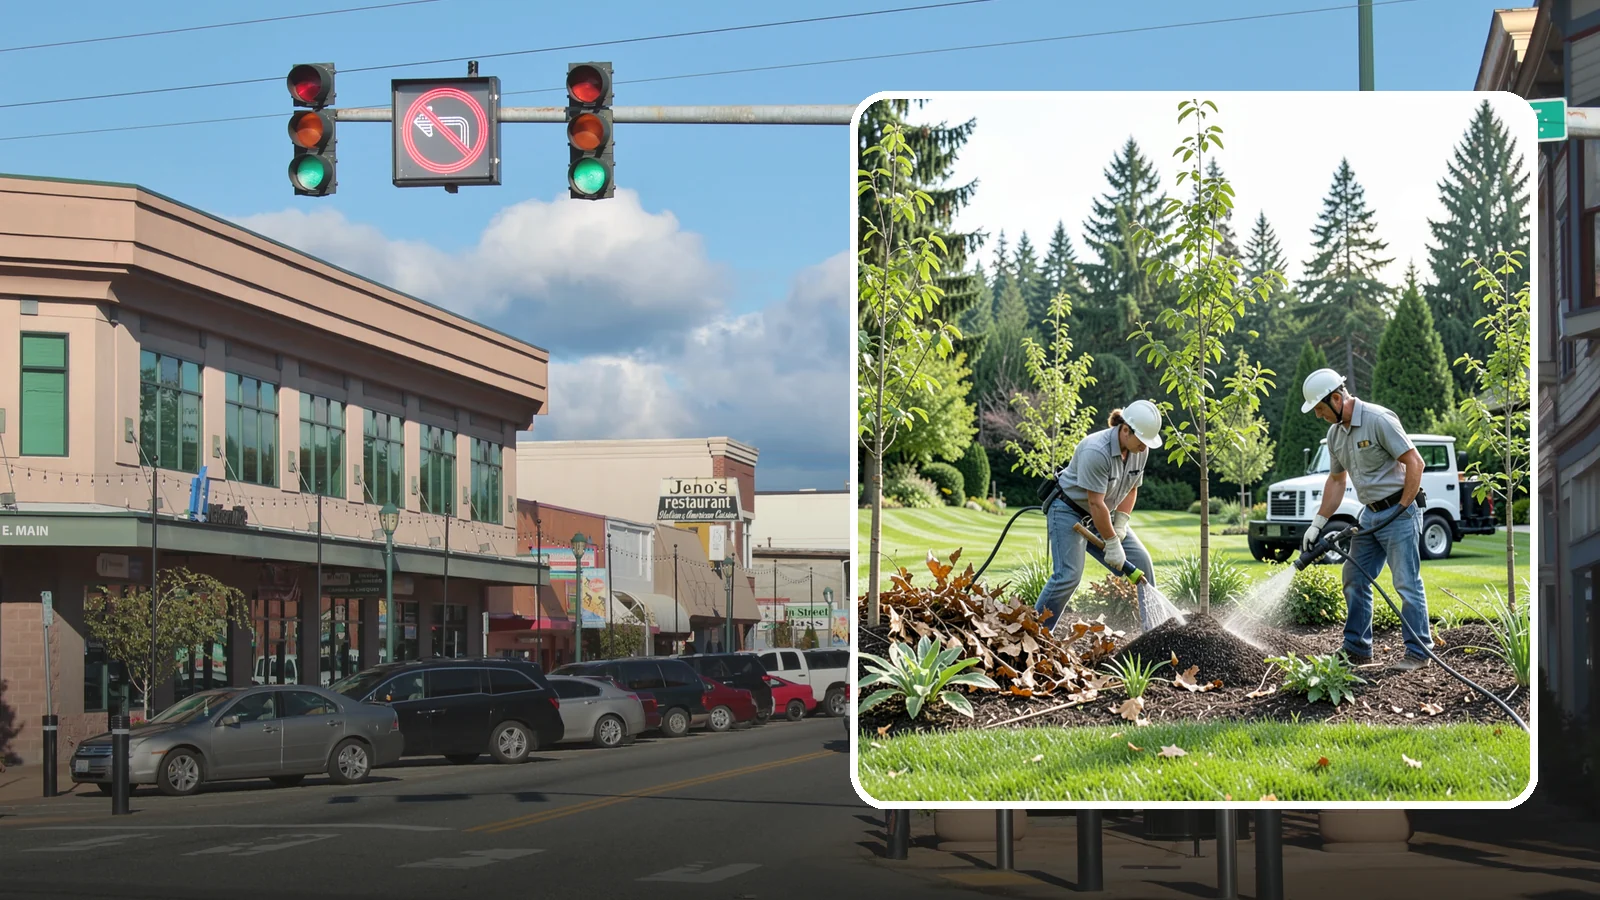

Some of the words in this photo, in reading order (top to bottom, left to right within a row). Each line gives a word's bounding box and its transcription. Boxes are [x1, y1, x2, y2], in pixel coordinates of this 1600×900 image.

[669, 480, 727, 494] Jeno's
[665, 496, 731, 509] restaurant
[686, 510, 714, 519] American
[715, 510, 737, 519] Cuisine
[2, 525, 13, 536] E.
[15, 525, 49, 536] MAIN
[797, 607, 829, 617] Street
[791, 619, 824, 627] lass
